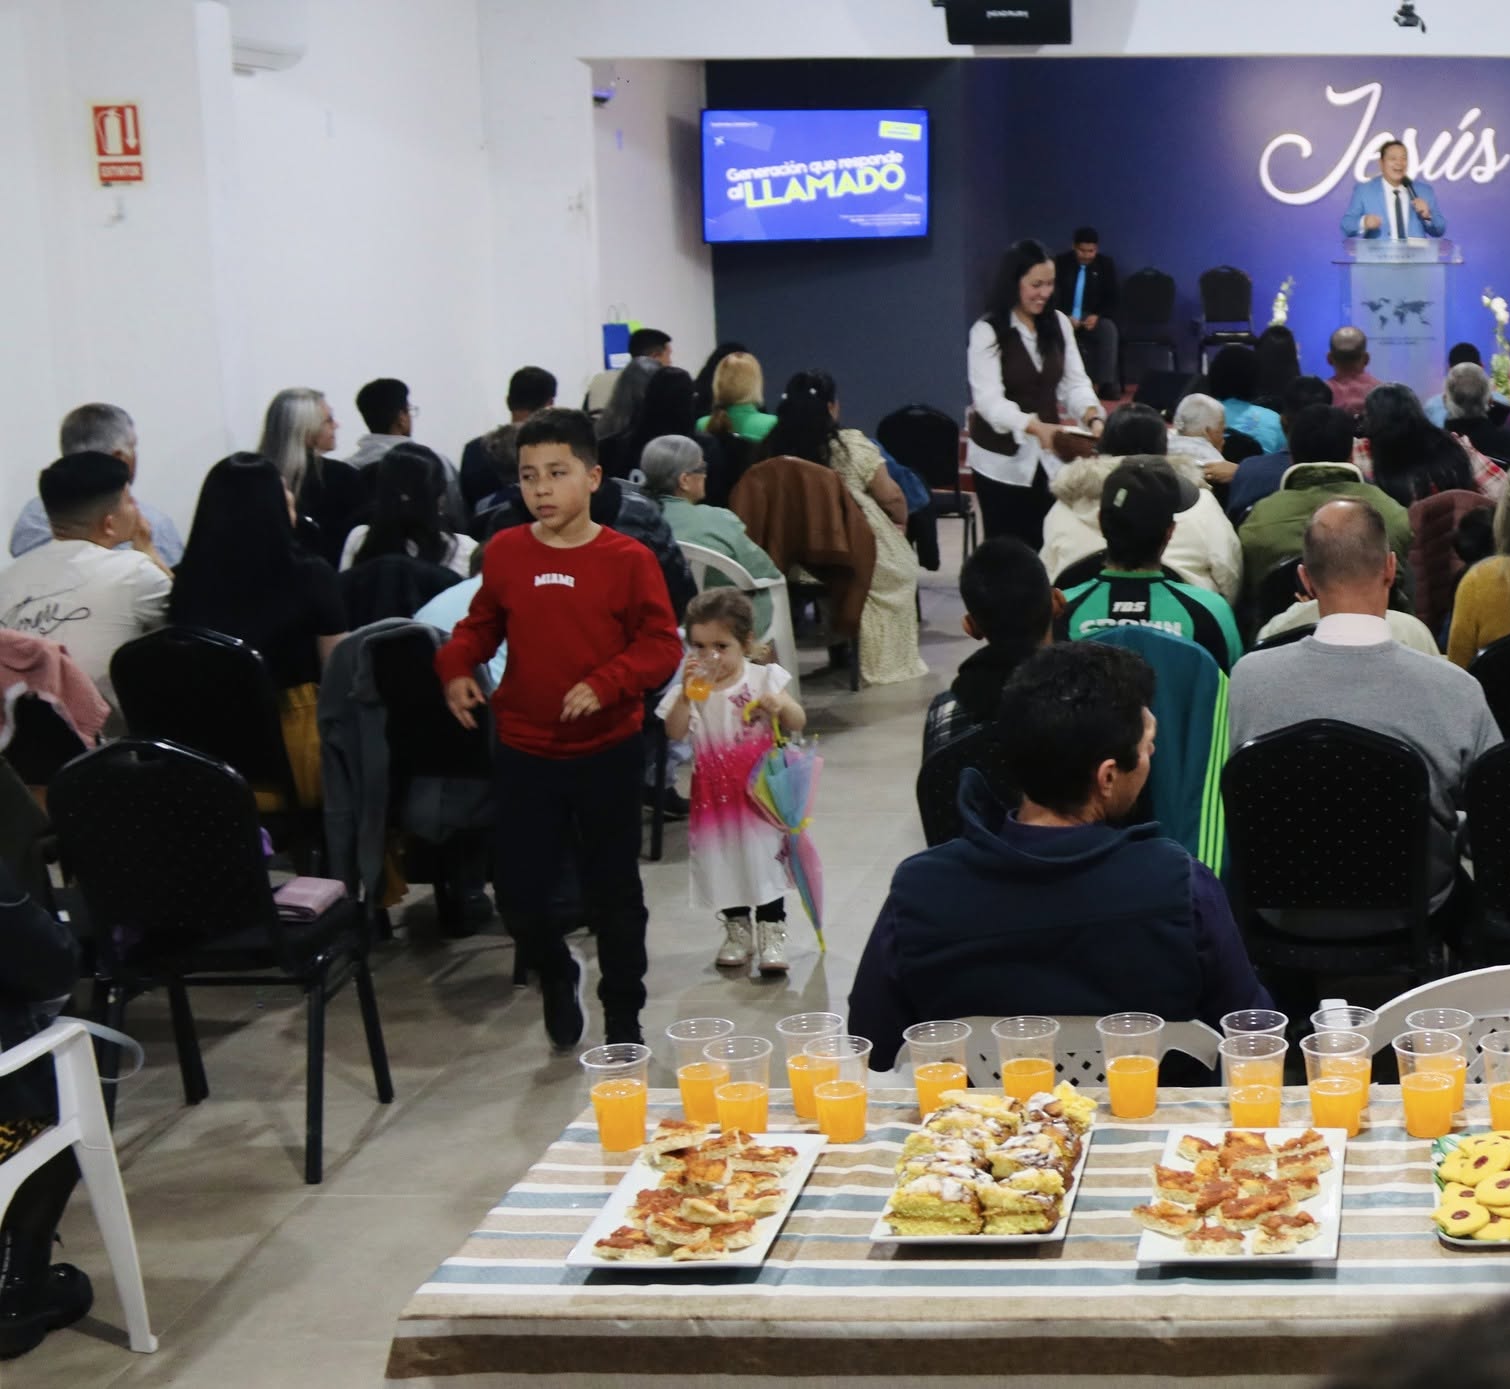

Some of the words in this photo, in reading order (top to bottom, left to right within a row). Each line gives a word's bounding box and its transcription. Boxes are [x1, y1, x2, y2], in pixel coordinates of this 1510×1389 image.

[726, 160, 808, 182] Generación
[809, 157, 837, 175] que
[838, 150, 904, 169] responde
[727, 183, 745, 200] al
[744, 163, 906, 208] LLAMADO
[533, 572, 576, 588] MIAMI
[1078, 618, 1183, 638] CWN
